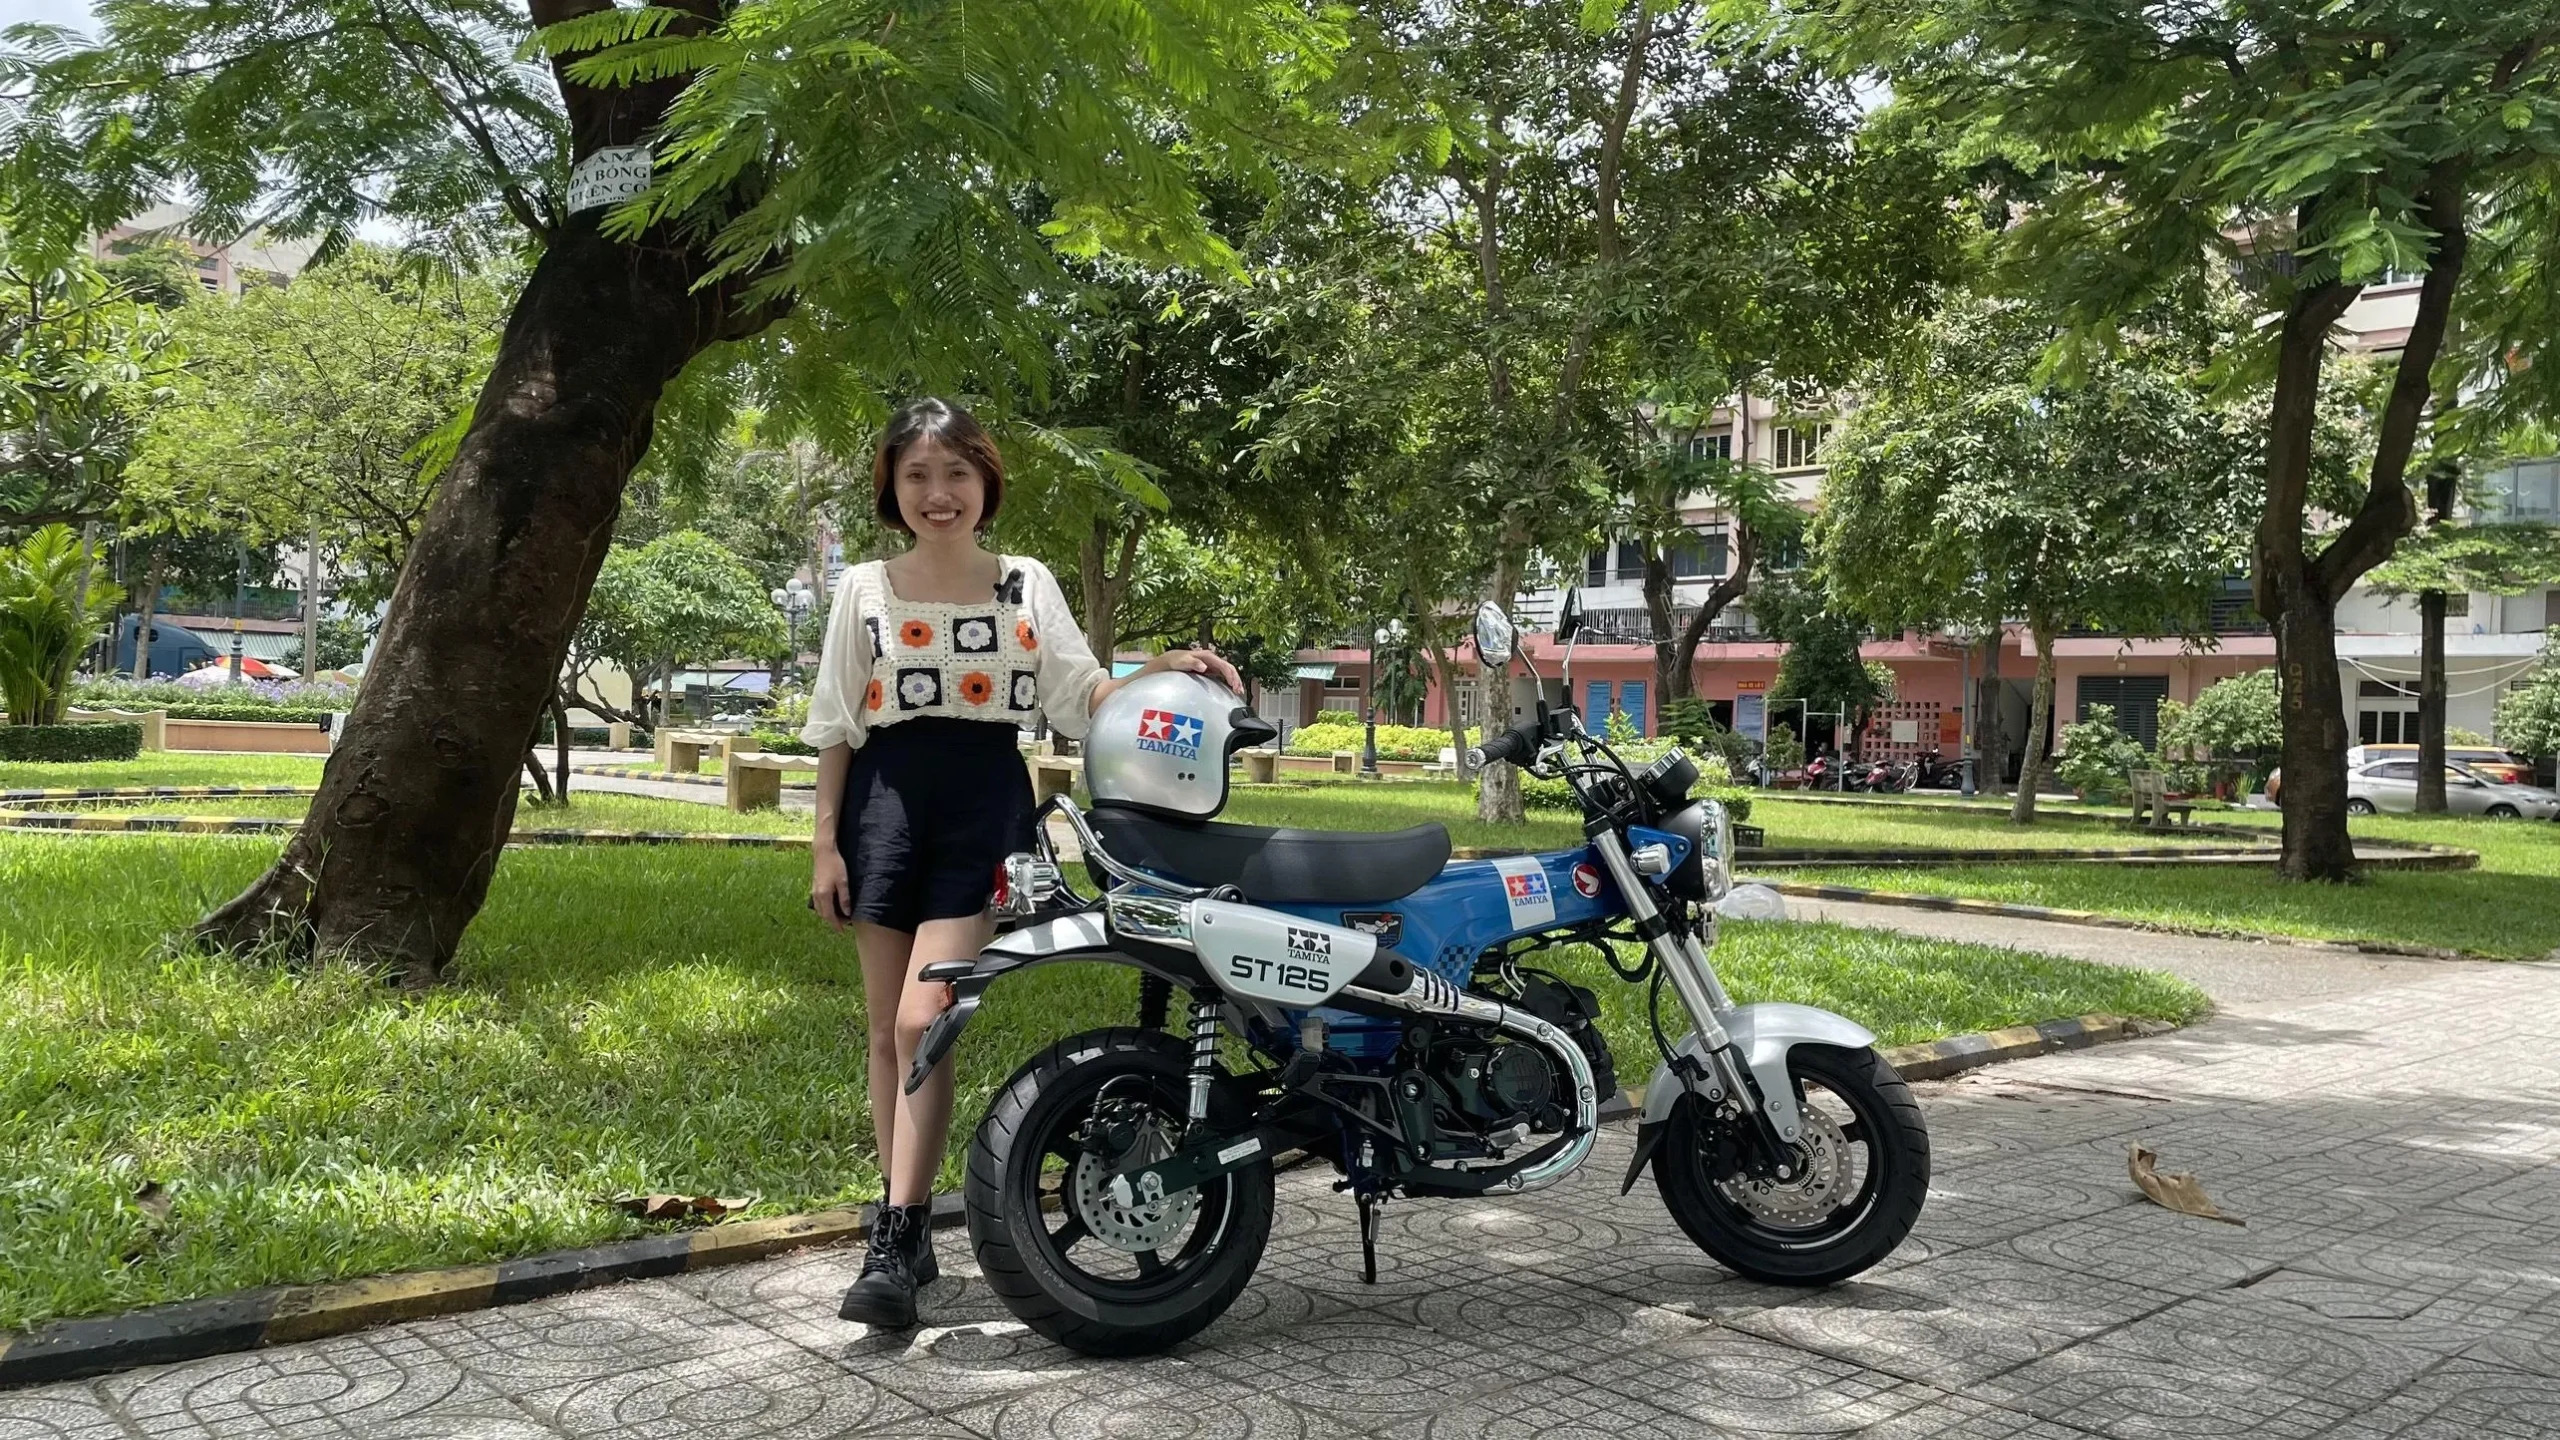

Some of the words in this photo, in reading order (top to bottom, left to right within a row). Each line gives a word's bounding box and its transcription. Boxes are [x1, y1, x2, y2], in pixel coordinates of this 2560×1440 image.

[595, 165, 647, 182] BÓNG
[1136, 738, 1198, 761] TAMIYA
[1512, 895, 1549, 907] TAMIYA
[1287, 948, 1331, 965] TAMIYA
